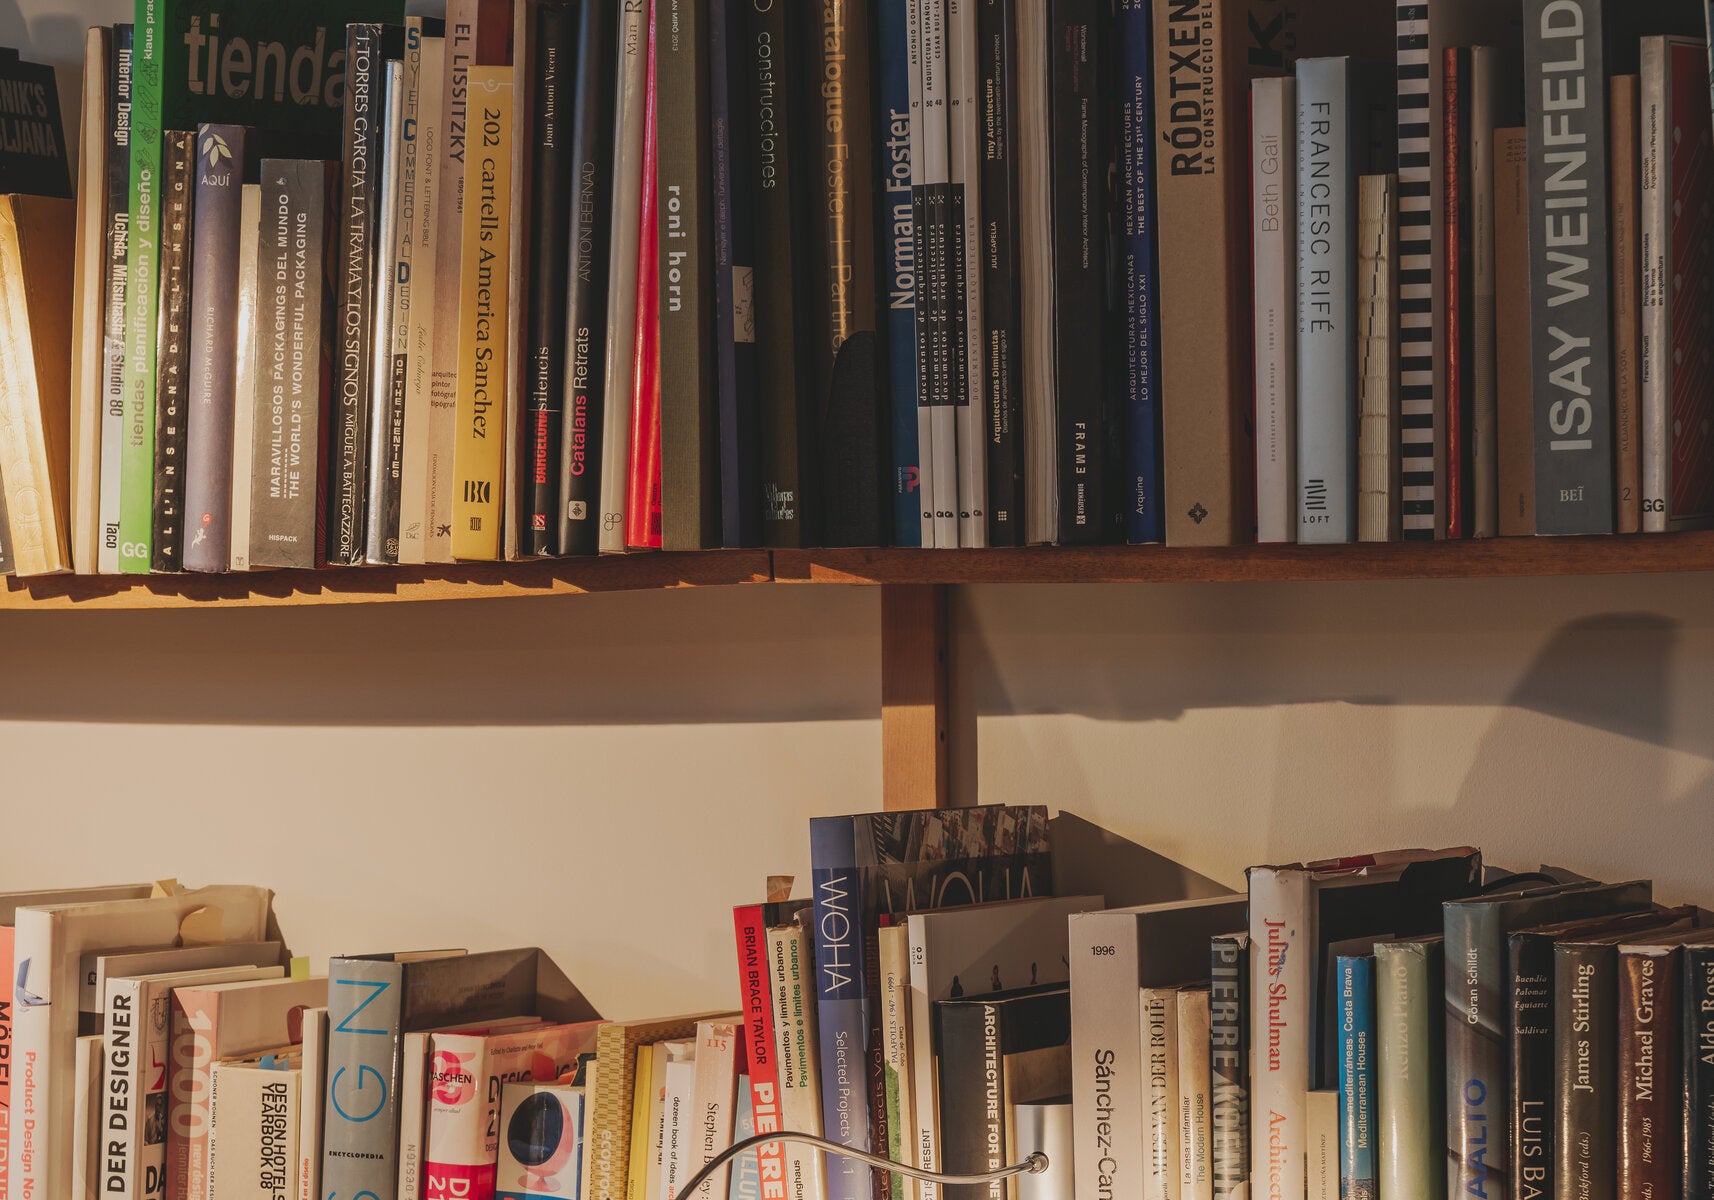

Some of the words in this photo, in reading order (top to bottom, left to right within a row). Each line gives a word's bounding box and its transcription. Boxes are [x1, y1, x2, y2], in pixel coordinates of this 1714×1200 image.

[184, 13, 346, 108] tienda
[455, 24, 470, 47] EL
[118, 49, 133, 100] Interior
[355, 47, 369, 112] TORRES
[113, 102, 131, 146] Design
[450, 55, 469, 163] LISSITZKY
[483, 108, 500, 147] 202
[757, 31, 777, 189] construcciones
[986, 78, 994, 138] Architecture
[352, 117, 368, 188] GARCIA
[886, 108, 912, 193] Foster
[1124, 102, 1132, 186] ARCHITECTURES
[1540, 0, 1590, 308] WEINFELD
[137, 169, 150, 232] diseño
[201, 173, 230, 187] AQUÍ
[351, 196, 365, 218] LA
[480, 158, 499, 241] cartells
[581, 161, 595, 224] BERNAD
[1311, 102, 1330, 255] FRANCESC
[278, 194, 289, 247] MUNDO
[668, 186, 686, 237] roni
[141, 238, 152, 250] y
[276, 252, 287, 281] DEL
[295, 212, 307, 299] PACKAGING
[349, 222, 364, 284] TRAMA
[578, 227, 592, 282] ANTONI
[890, 204, 915, 310] Norman
[133, 242, 151, 375] planificación
[476, 247, 498, 342] America
[668, 252, 687, 311] horn
[1127, 254, 1136, 313] MEXICANAS
[1139, 294, 1147, 324] SIGLO
[1311, 270, 1334, 333] RIFÉ
[273, 285, 287, 379] PACKAGINGS
[292, 304, 304, 393] WONDERFUL
[345, 303, 361, 336] LOS
[1140, 327, 1148, 347] DEL
[343, 337, 361, 406] SIGNOS
[539, 346, 549, 411] silencis
[573, 327, 589, 389] Retrats
[991, 329, 999, 378] Diminutas
[1128, 316, 1136, 400] ARQUITECTURAS
[1140, 350, 1148, 384] MEJOR
[131, 379, 145, 447] tiendas
[473, 347, 493, 439] Sanchez
[993, 379, 1001, 444] Arquitecturas
[1141, 387, 1148, 400] LO
[1548, 326, 1592, 450] ISAY
[270, 385, 284, 498] MARAVILLOSOS
[290, 400, 301, 463] WORLD'S
[570, 394, 587, 476] Catalans
[289, 470, 300, 499] THE
[1136, 476, 1145, 514] Arquine
[106, 522, 120, 549] Taco
[268, 534, 298, 543] HISPACK
[1303, 514, 1330, 523] LOFT
[744, 927, 757, 967] BRIAN
[820, 876, 851, 993] WOHA
[1091, 945, 1115, 956] 1996
[1265, 918, 1286, 976] Julius
[749, 971, 763, 1013] BRACE
[1572, 964, 1595, 1032] Stirling
[1636, 959, 1654, 1024] Graves
[753, 1017, 767, 1065] TAYLOR
[836, 1031, 850, 1085] Selected
[1268, 983, 1287, 1072] Shulman
[1357, 1031, 1366, 1071] Houses
[25, 1051, 36, 1114] Product
[109, 994, 131, 1131] DESIGNER
[171, 1009, 213, 1139] 1000
[984, 1004, 999, 1120] ARCHITECTURE
[1573, 1040, 1594, 1093] James
[1635, 1031, 1653, 1101] Michael
[261, 1083, 275, 1169] YEARBOOK
[273, 1083, 287, 1141] DESIGN
[704, 1103, 719, 1151] Stephen
[754, 1082, 784, 1199] PIERRE
[838, 1089, 850, 1137] Projects
[988, 1124, 999, 1154] FOR
[1358, 1074, 1367, 1149] Mediterranean
[1522, 1101, 1545, 1158] LUIS
[21, 1119, 35, 1172] Design
[107, 1141, 127, 1193] DER
[260, 1173, 273, 1190] 08
